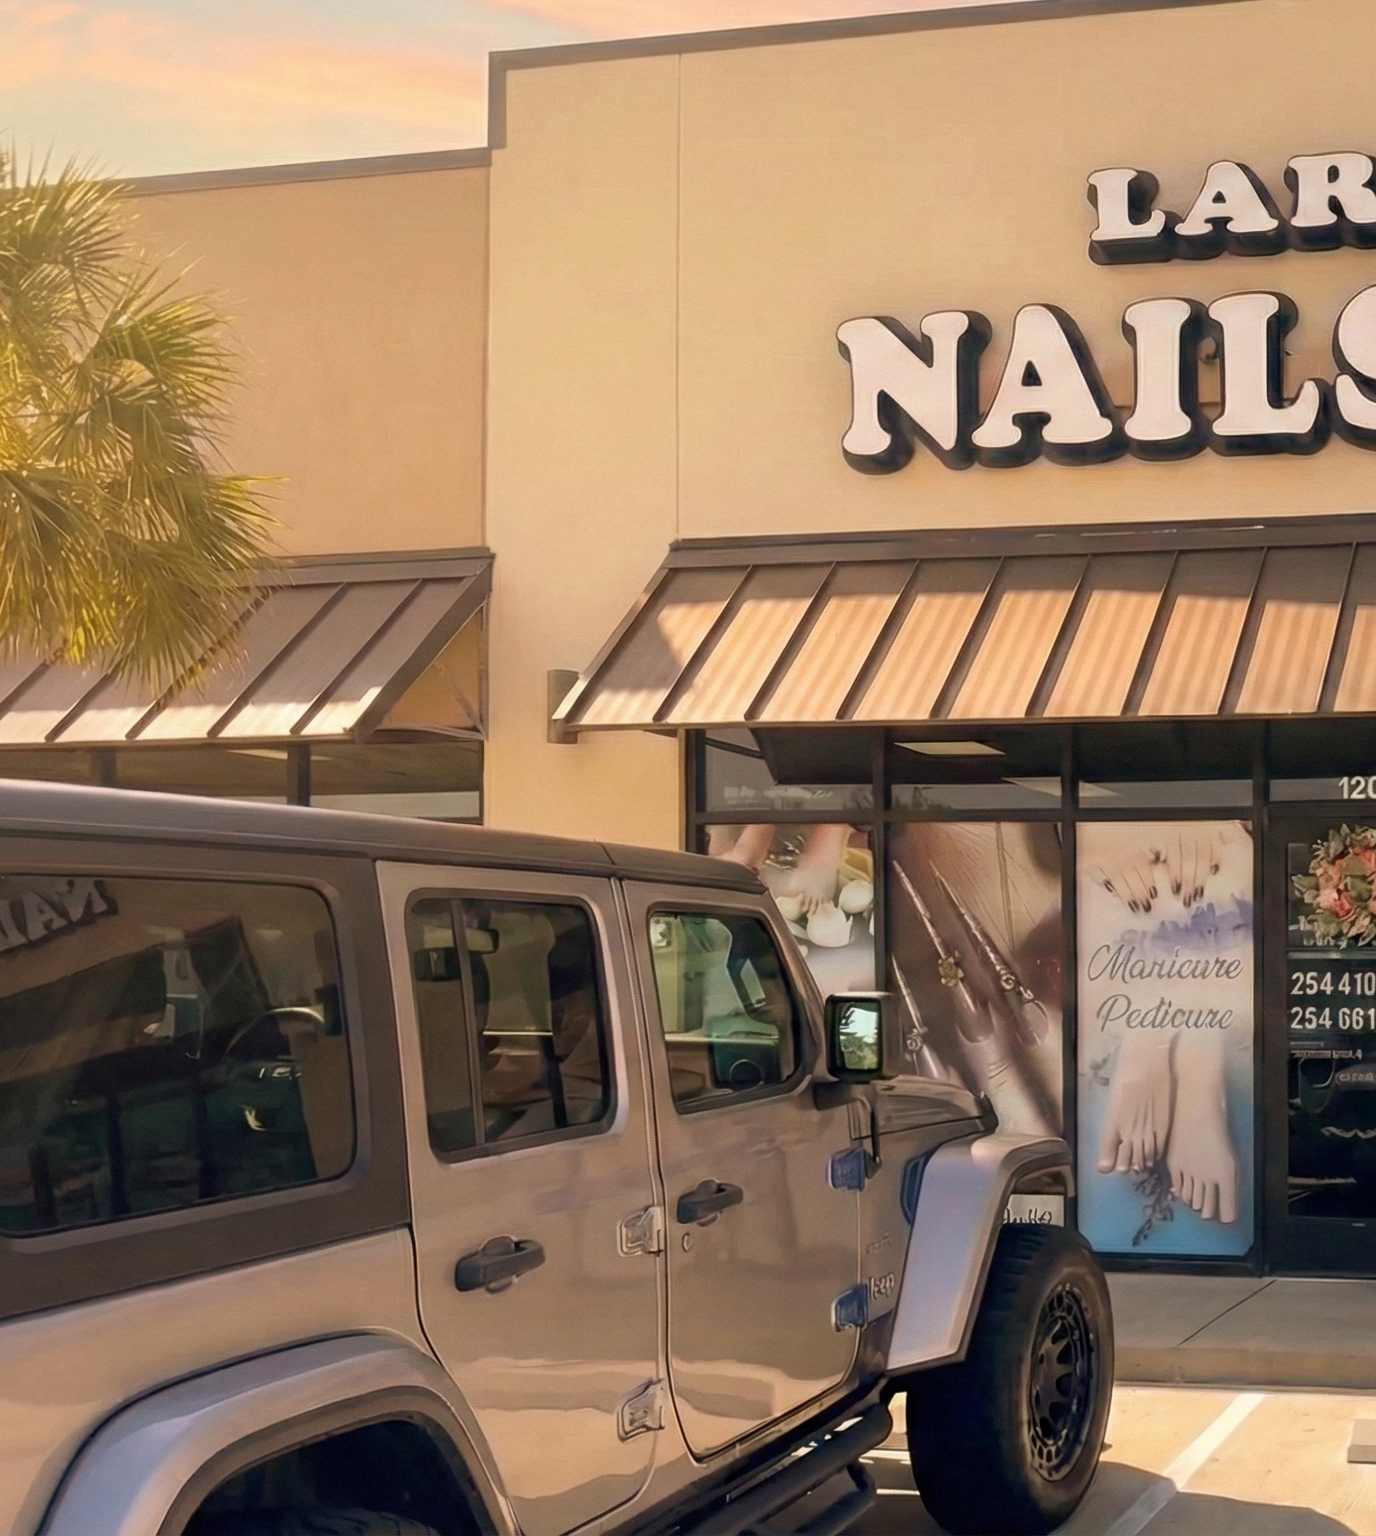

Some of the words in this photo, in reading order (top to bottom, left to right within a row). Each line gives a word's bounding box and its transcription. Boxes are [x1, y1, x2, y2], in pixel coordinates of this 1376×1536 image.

[1087, 943, 1244, 984] Manicure
[1290, 972, 1334, 995] 254
[1338, 972, 1376, 996] 410
[1096, 994, 1236, 1034] Pedicure
[1290, 1006, 1332, 1029] 254
